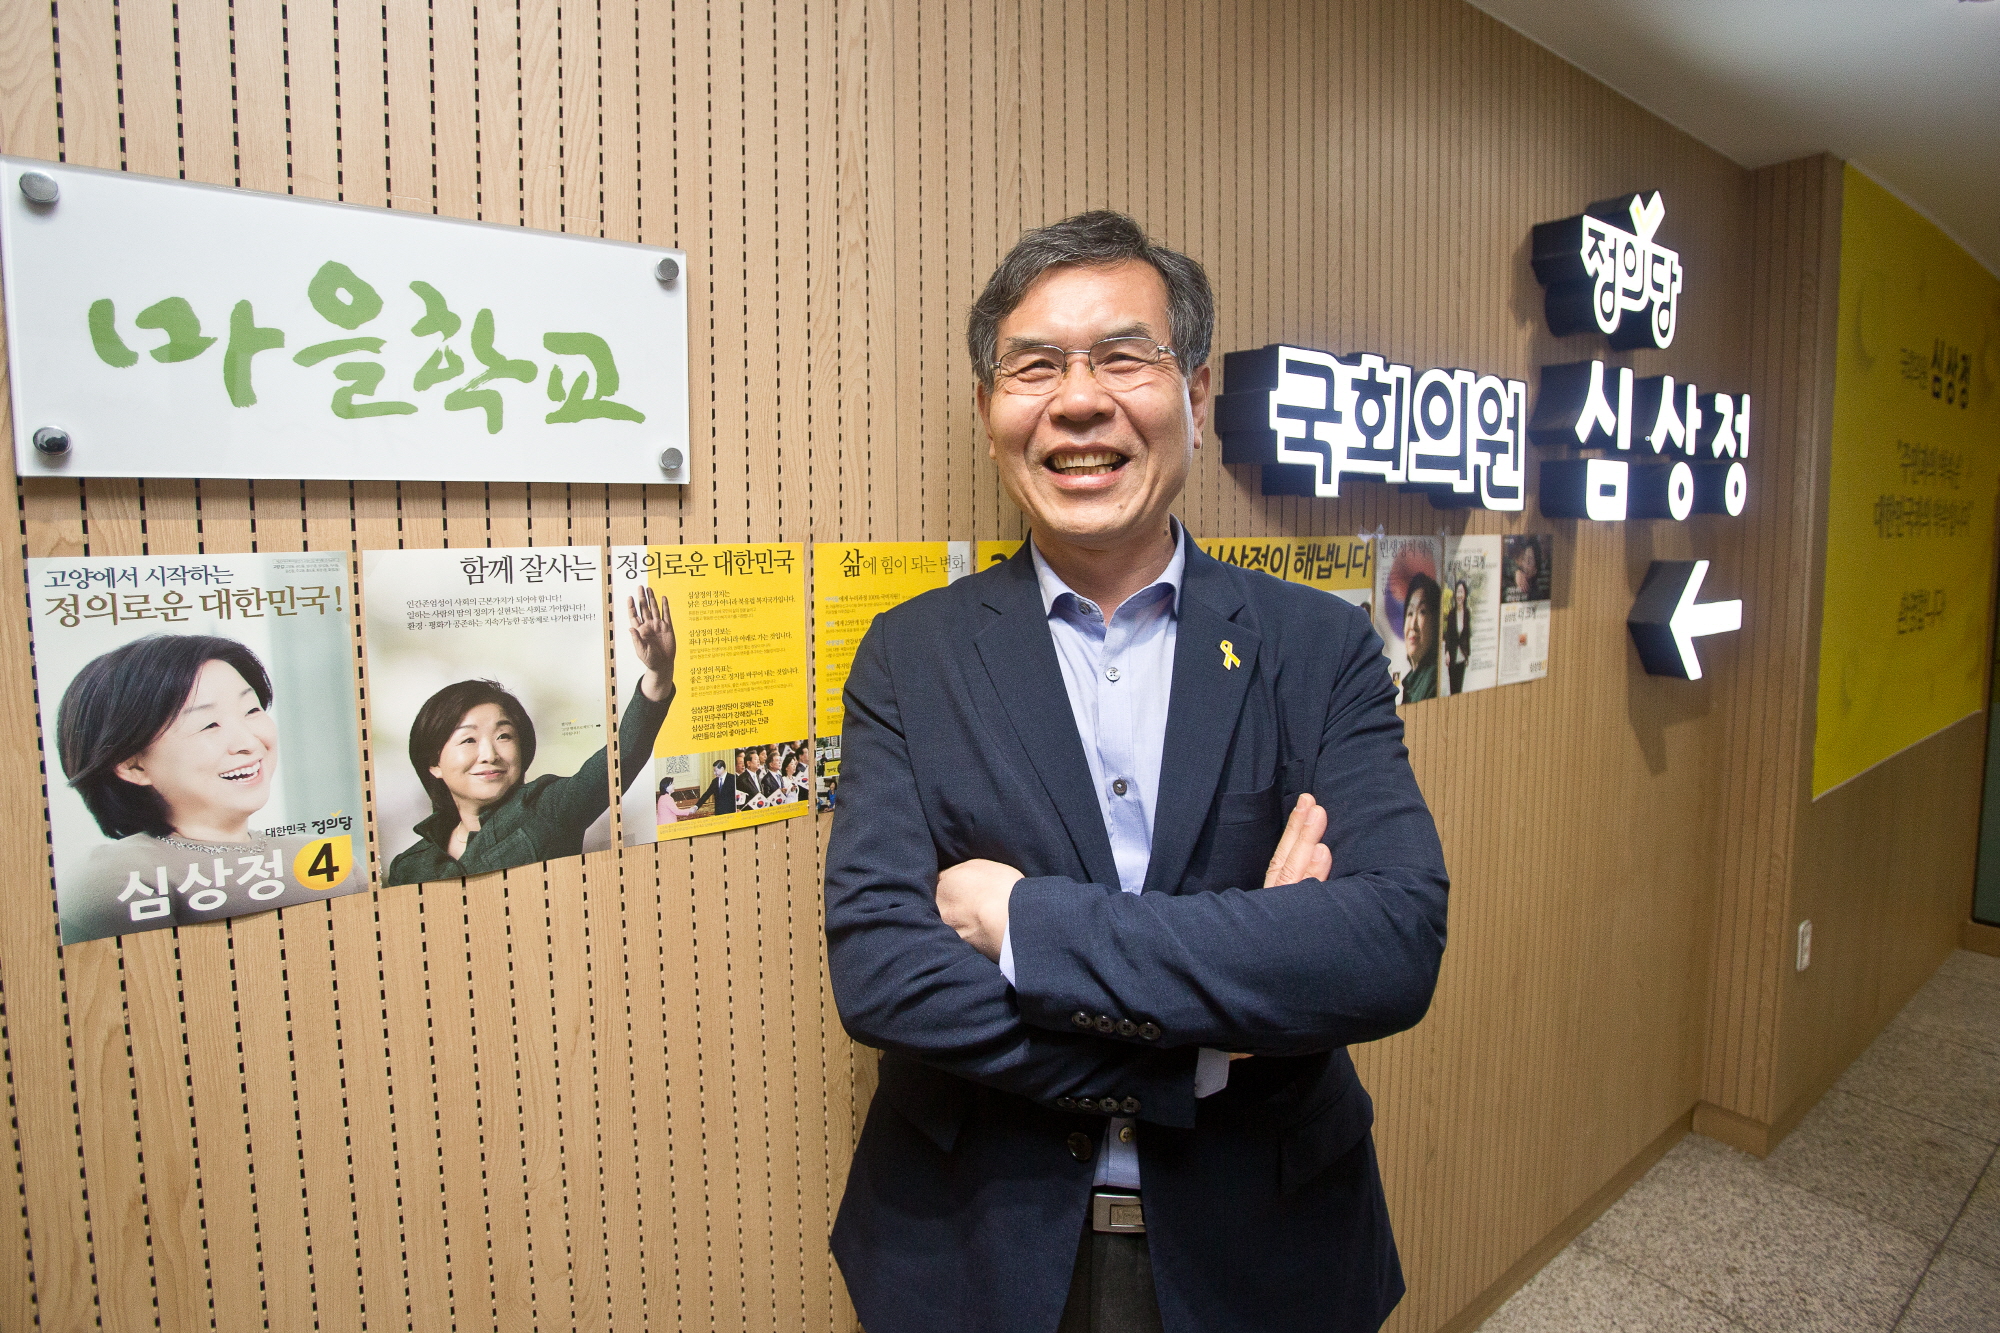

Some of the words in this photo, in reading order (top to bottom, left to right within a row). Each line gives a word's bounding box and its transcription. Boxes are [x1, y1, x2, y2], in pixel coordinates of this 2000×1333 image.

[1580, 214, 1684, 349] 정의당
[89, 260, 646, 435] 마을학교
[1269, 344, 1528, 512] 국회의원
[1575, 360, 1751, 521] 심상정
[460, 555, 514, 585] 함께
[519, 554, 597, 583] 잘사는
[616, 550, 709, 580] 정의로운
[713, 549, 795, 577] 대한민국
[839, 548, 877, 578] 삶에
[881, 556, 907, 575] 힘이
[911, 555, 937, 573] 되는
[940, 554, 966, 574] 변화
[1294, 543, 1371, 580] 해냅니다
[43, 567, 139, 590] 고양에서
[145, 564, 234, 587] 시작하는
[407, 599, 453, 608] 인간존엄성이
[454, 597, 477, 607] 사회의
[478, 596, 514, 605] 근본가치가
[516, 595, 537, 604] 되어야
[538, 594, 562, 604] 합니다!
[688, 590, 712, 599] 심상정의
[713, 590, 730, 599] 정치는
[702, 599, 719, 608] 진보가
[44, 589, 193, 628] 정의로운
[199, 584, 343, 621] 대한민국!
[406, 610, 430, 619] 일하는
[473, 607, 495, 617] 정의가
[497, 606, 526, 615] 실현되는
[526, 605, 548, 613] 사회로
[407, 621, 423, 630] 환경
[428, 620, 451, 629] 평화가
[453, 619, 483, 628] 공존하는
[484, 617, 520, 626] 지속가능한
[521, 615, 550, 625] 공동체로
[572, 613, 596, 622] 합니다!
[689, 629, 713, 637] 심상정의
[713, 627, 732, 636] 진보는
[690, 666, 714, 675] 심상정의
[691, 705, 715, 715] 심상정과
[715, 702, 739, 713] 정의당이
[739, 700, 762, 710] 강해지는
[762, 698, 774, 707] 만큼
[691, 714, 703, 723] 우리
[704, 711, 733, 722] 민주주의가
[692, 723, 715, 732] 심상정과
[716, 720, 739, 730] 정의당이
[739, 718, 757, 727] 커지는
[757, 716, 769, 725] 만큼
[692, 731, 715, 741] 서민들의
[716, 730, 728, 739] 삶이
[265, 823, 307, 837] 대한민국
[311, 816, 353, 834] 정의당
[117, 849, 286, 922] 심상정
[308, 843, 339, 882] 4
